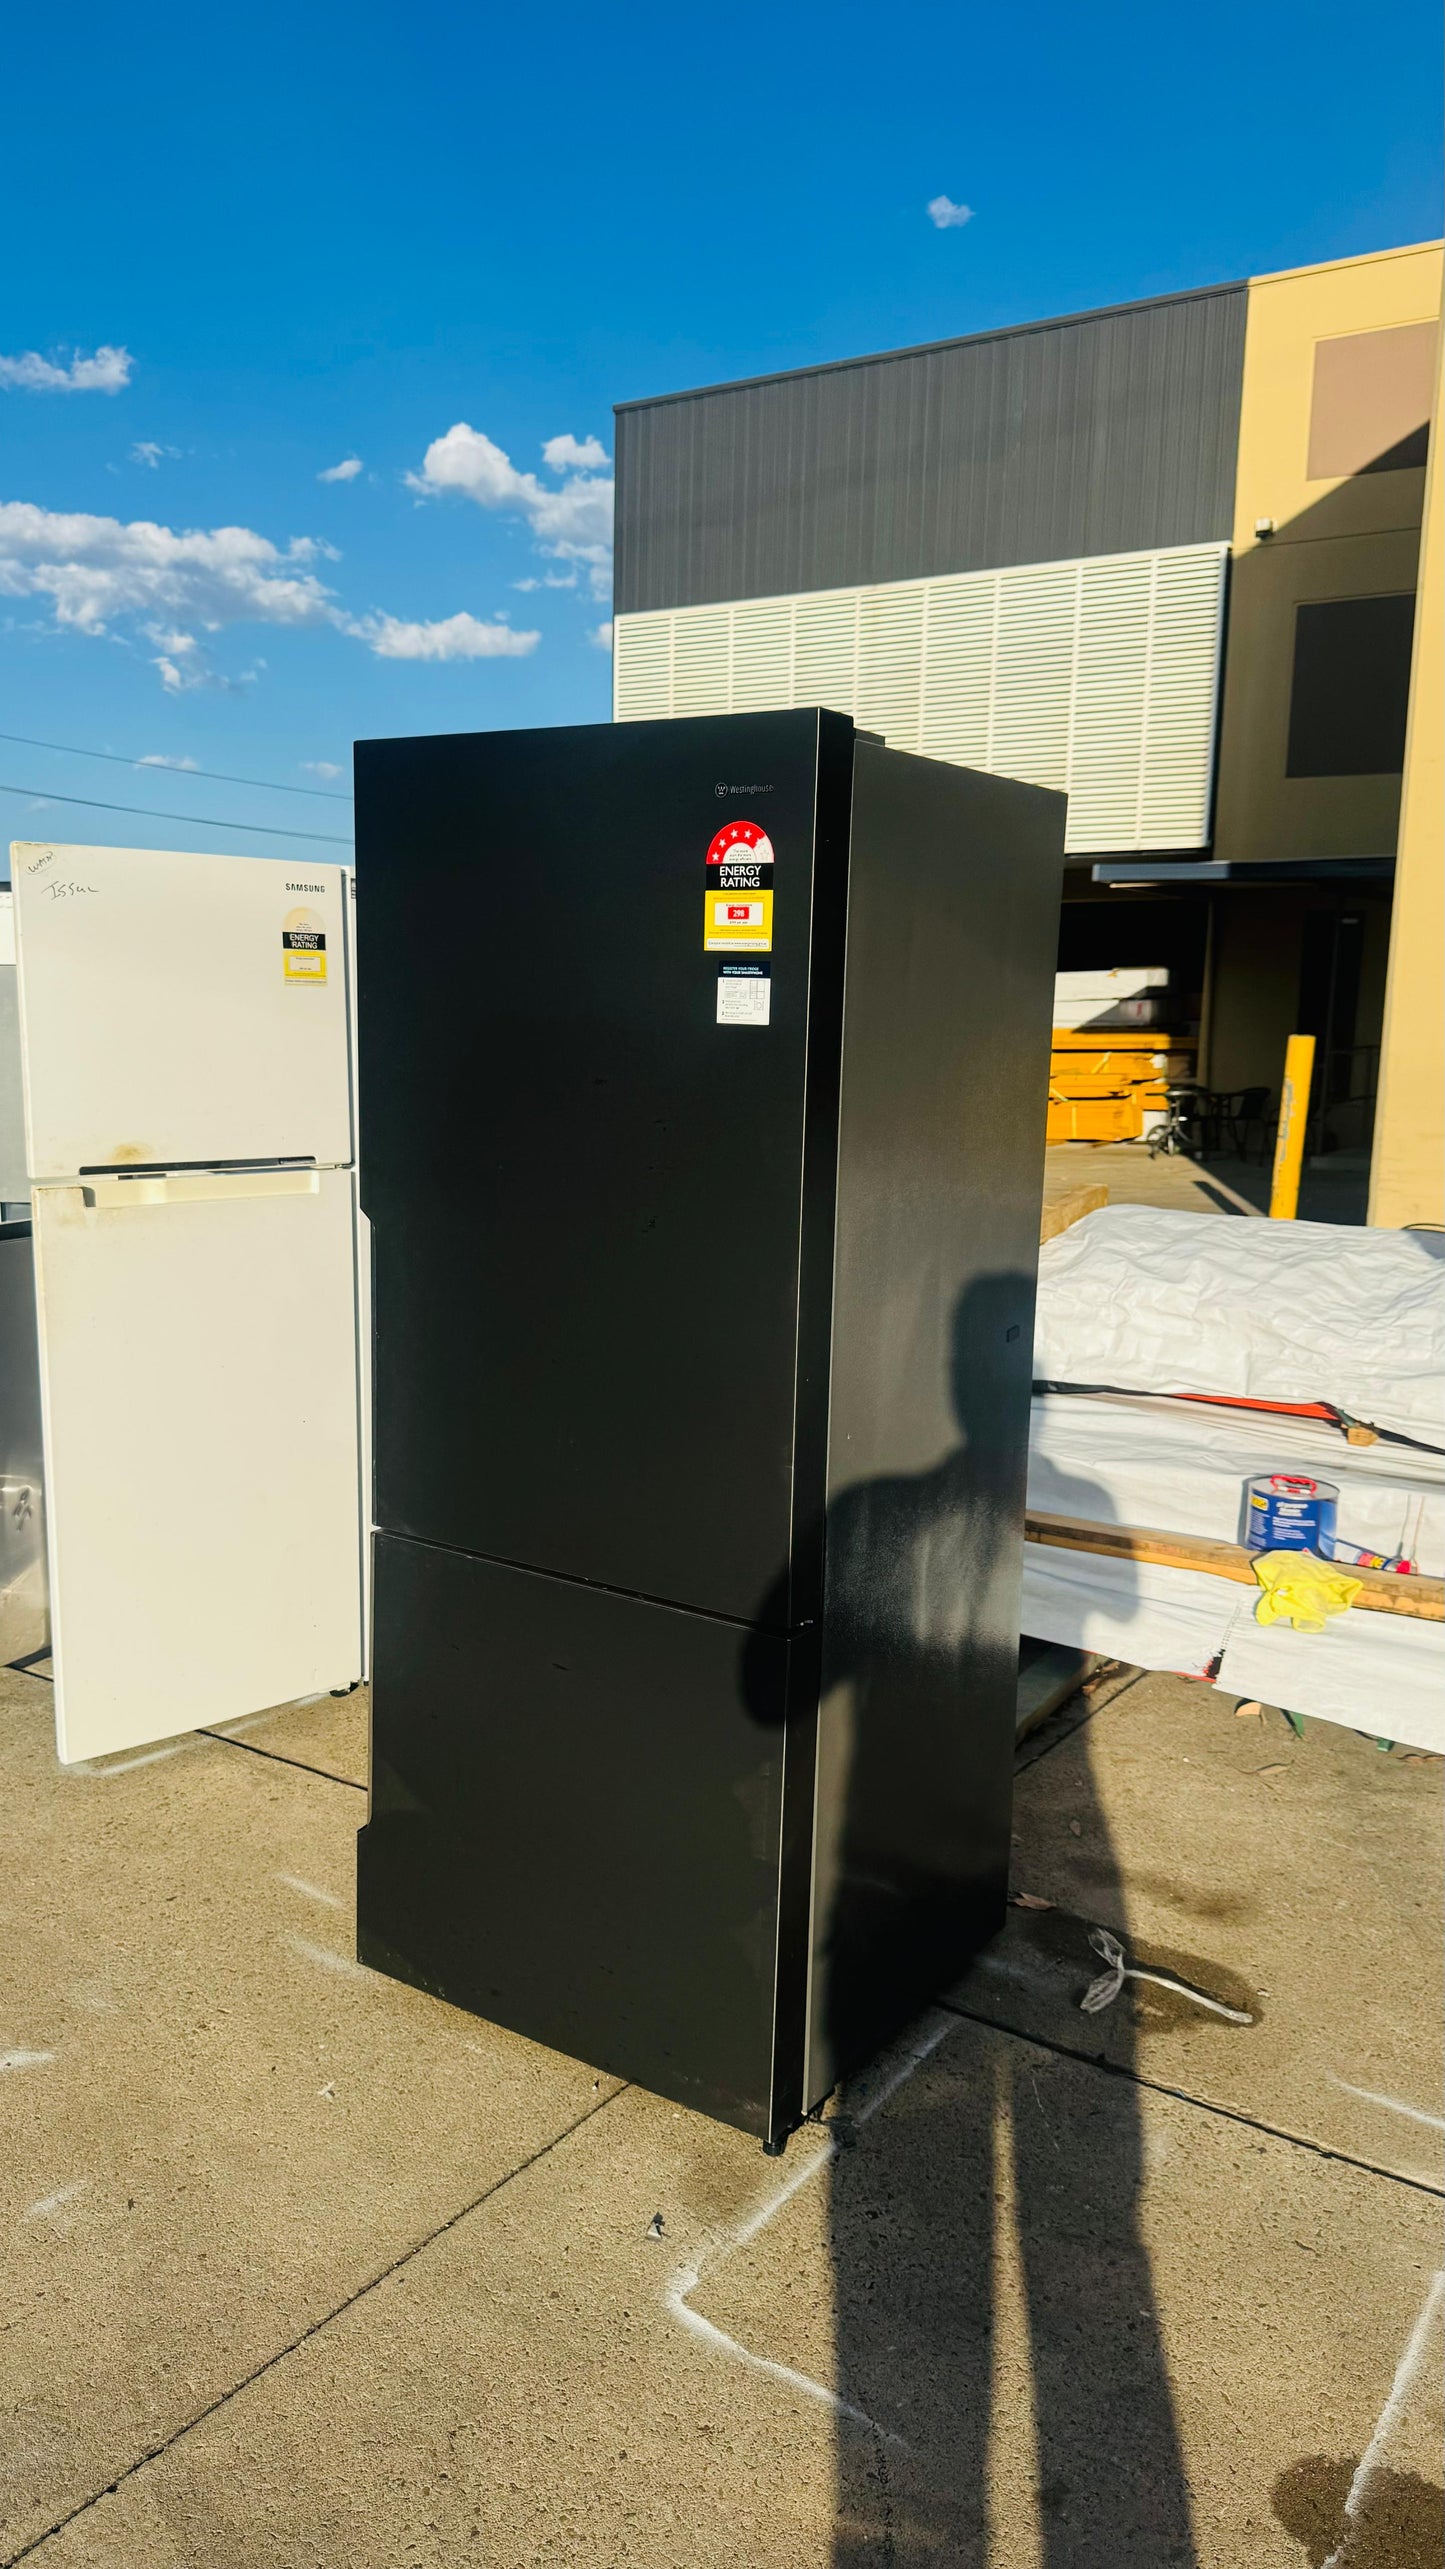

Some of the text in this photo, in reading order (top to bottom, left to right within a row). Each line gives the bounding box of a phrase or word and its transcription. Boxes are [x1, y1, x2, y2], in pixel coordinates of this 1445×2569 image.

[730, 784, 774, 796] Westinghouse
[719, 865, 762, 876] ENERGY
[285, 882, 326, 893] SAMSUNG
[720, 876, 760, 888] RATING
[289, 933, 320, 943] ENERGY
[291, 941, 318, 950] RATING
